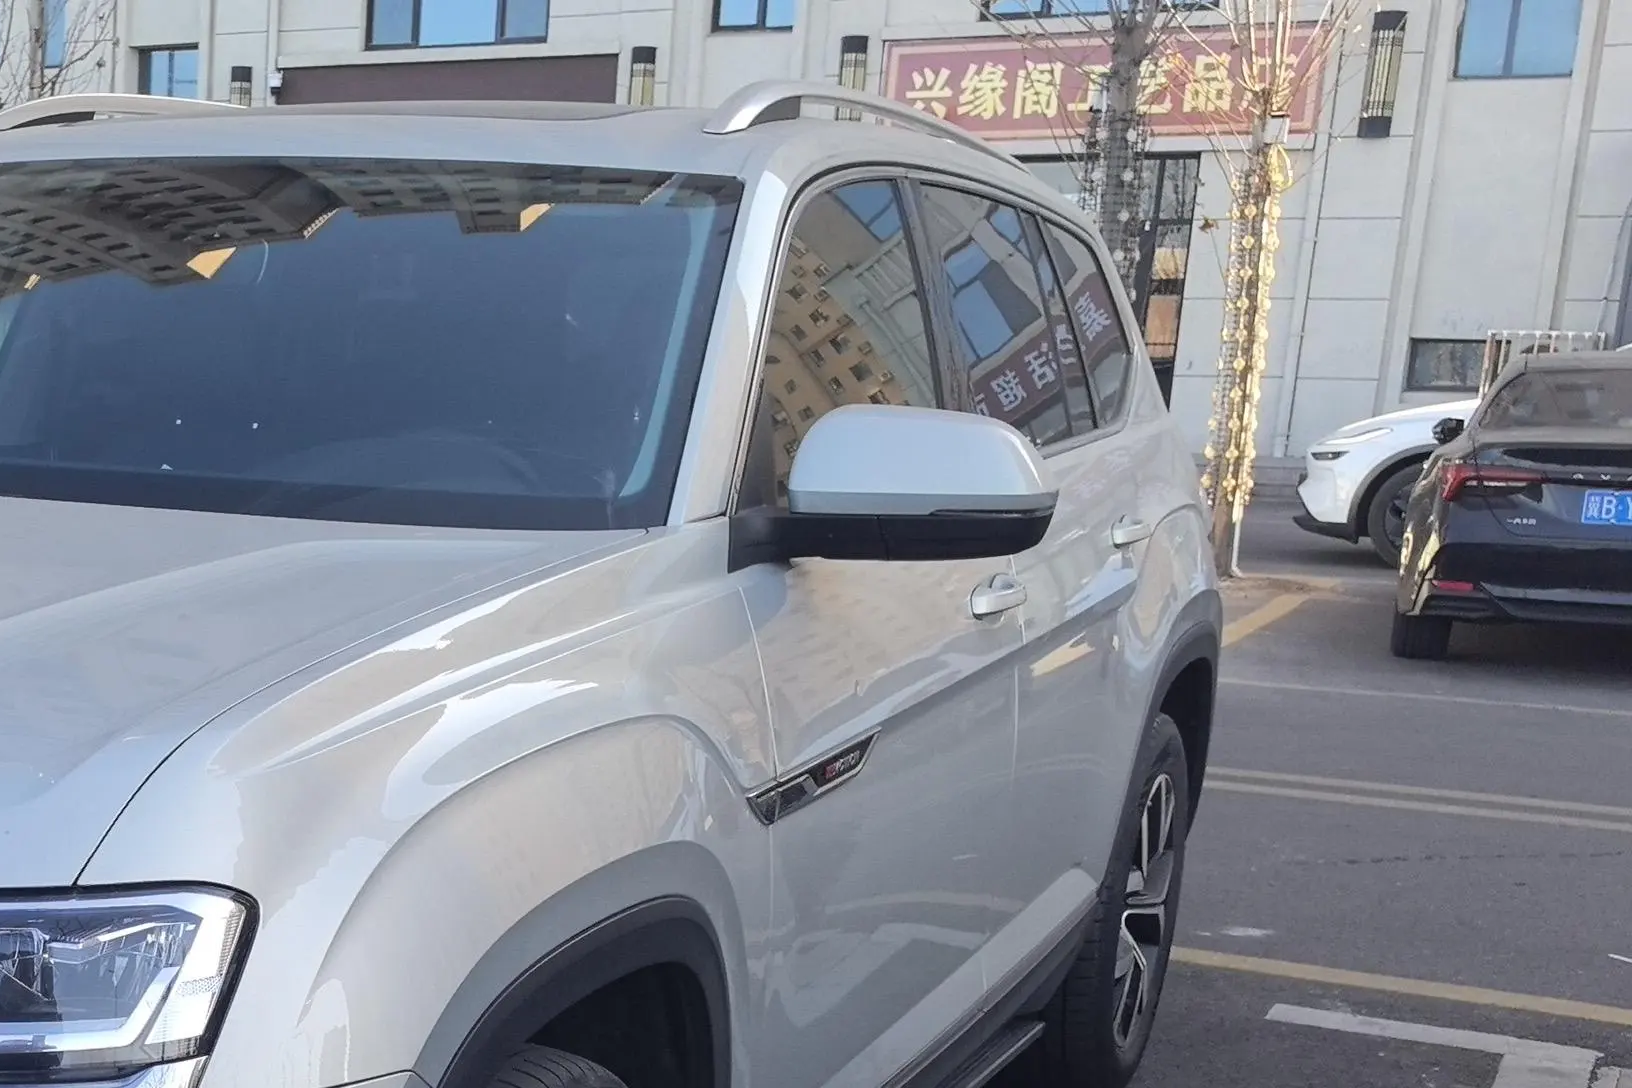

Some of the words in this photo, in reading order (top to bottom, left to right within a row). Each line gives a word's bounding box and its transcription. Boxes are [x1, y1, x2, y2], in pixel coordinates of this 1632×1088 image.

[906, 53, 1297, 119] 兴缘阁工艺品
